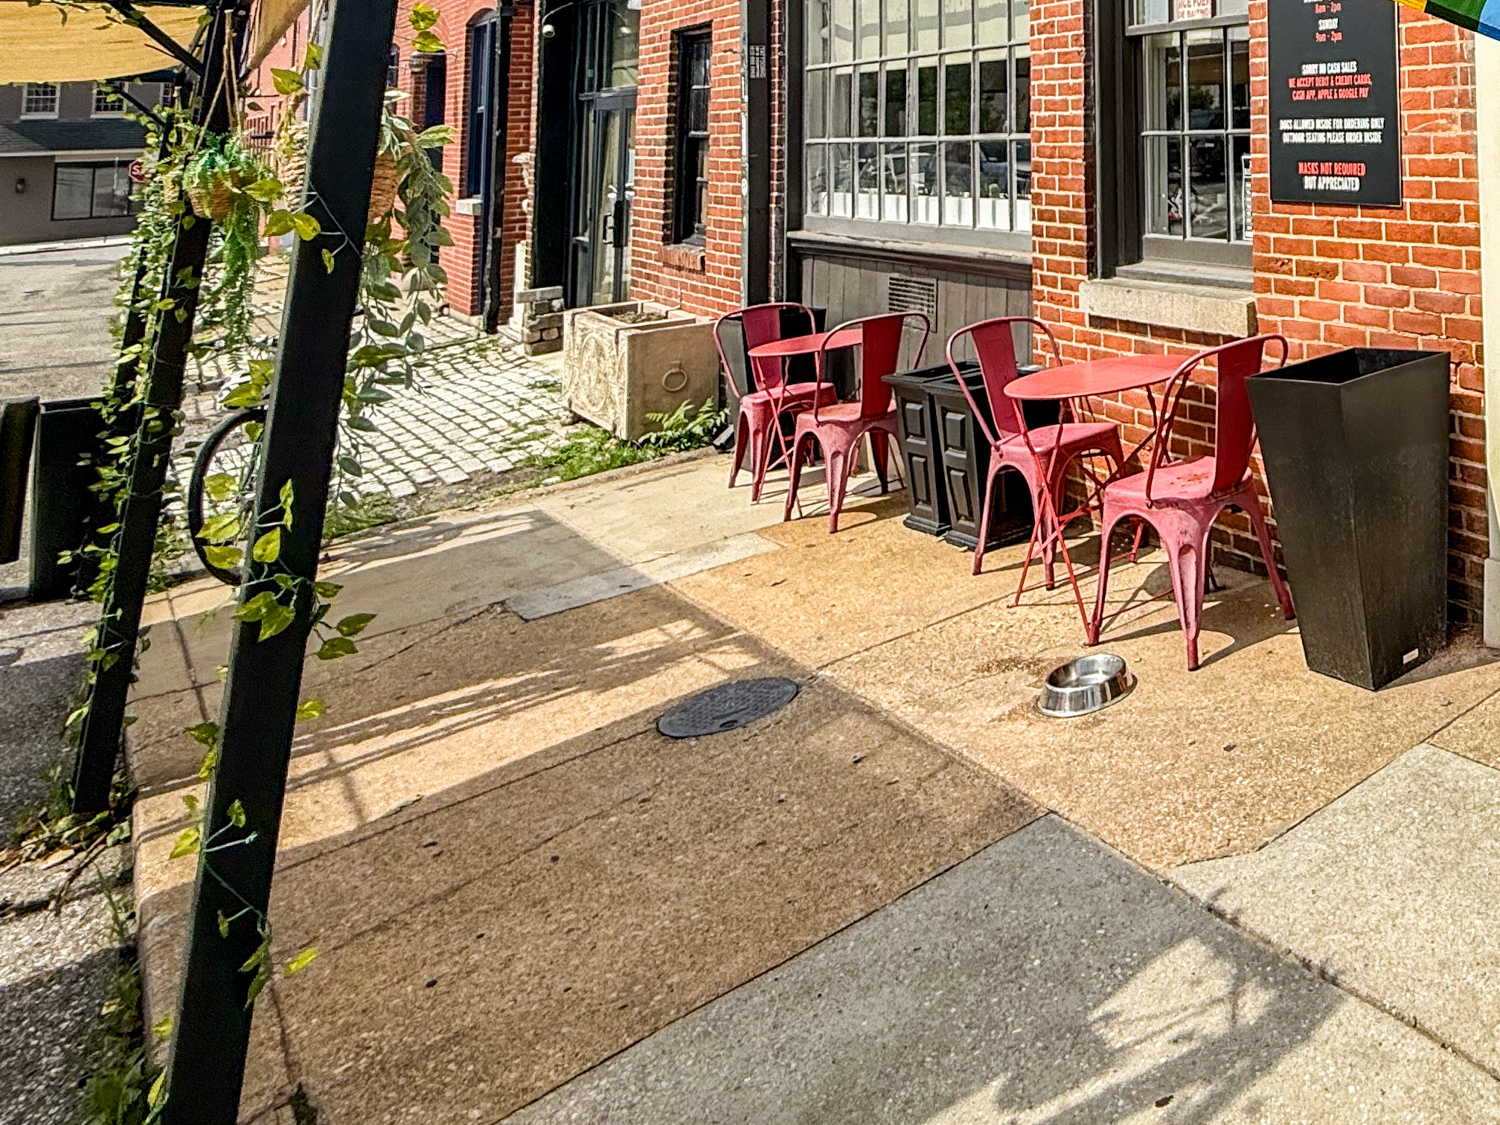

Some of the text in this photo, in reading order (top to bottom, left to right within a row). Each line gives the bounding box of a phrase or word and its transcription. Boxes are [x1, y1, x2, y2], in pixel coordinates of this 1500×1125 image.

[1318, 18, 1338, 30] SUNDAY
[1302, 61, 1358, 75] SORRY NO CASH SALES
[1288, 78, 1296, 88] WE
[1296, 77, 1314, 88] ACCEPT
[1315, 76, 1329, 87] DEBIT
[1335, 75, 1353, 86] CREDIT
[1292, 90, 1305, 101] CASH
[1317, 88, 1333, 100] APPLE
[1338, 87, 1358, 99] GOOGLE
[1359, 87, 1369, 98] PAY
[1279, 117, 1385, 130] DOGS ALLOWED INSIDE FOR ORDERING ONLY
[1282, 131, 1383, 144] OUTDOOR SEATING PLEASE ORDER INSIDE
[1298, 162, 1366, 176] MASKS NOT REQUIRED
[1304, 176, 1360, 191] BUT APPRECIATED
